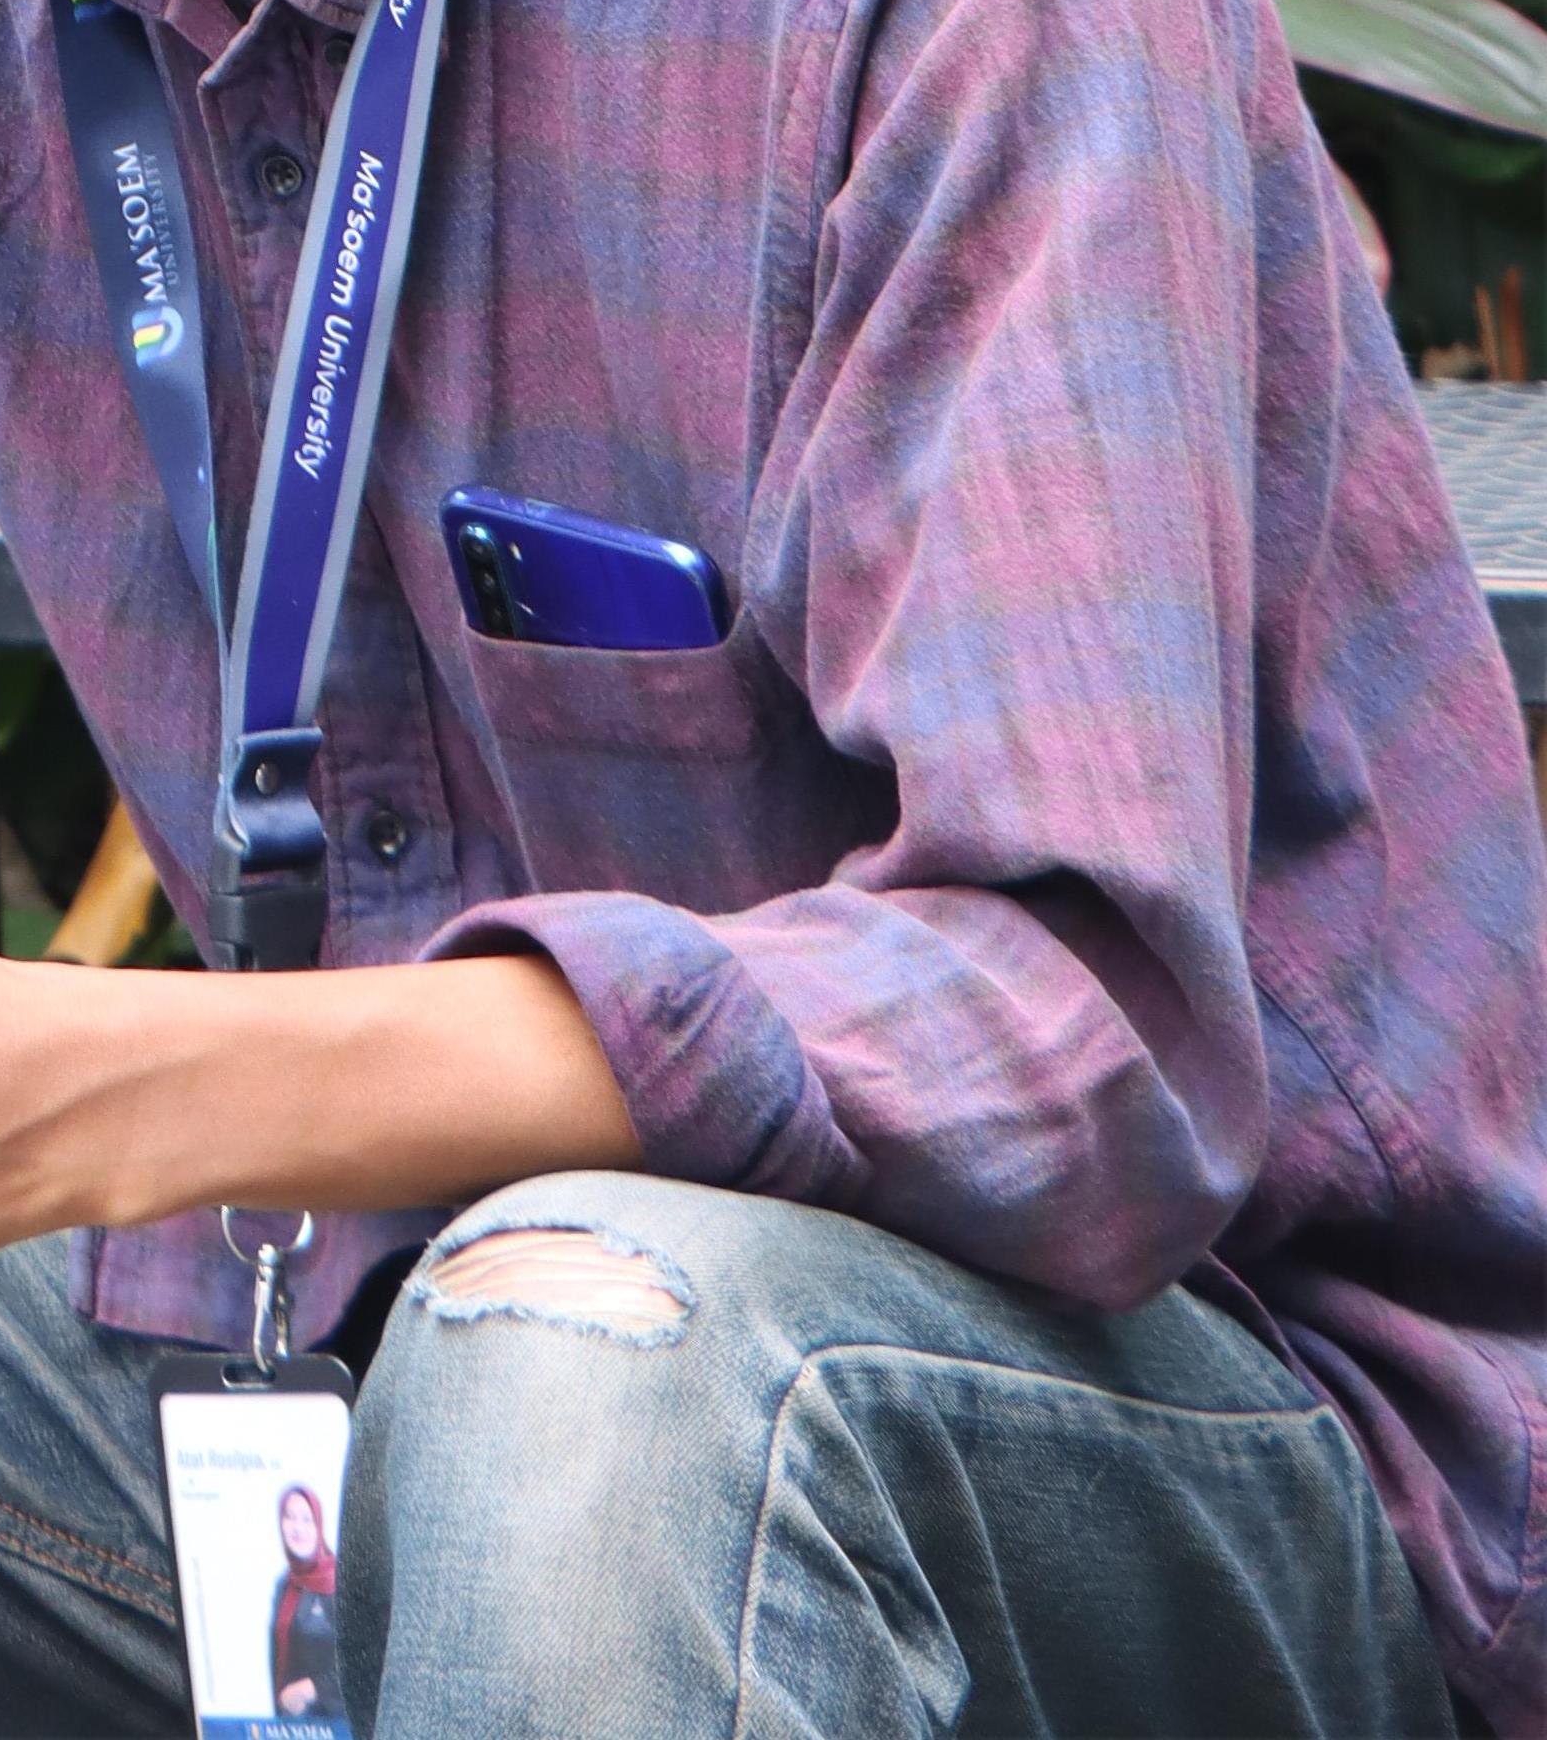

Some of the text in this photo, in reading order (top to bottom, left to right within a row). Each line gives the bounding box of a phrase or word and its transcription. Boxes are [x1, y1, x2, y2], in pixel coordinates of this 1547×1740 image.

[113, 142, 168, 302] MA'SOEM
[143, 153, 179, 287] UNIVERSITY
[294, 149, 384, 481] Ma'soem University
